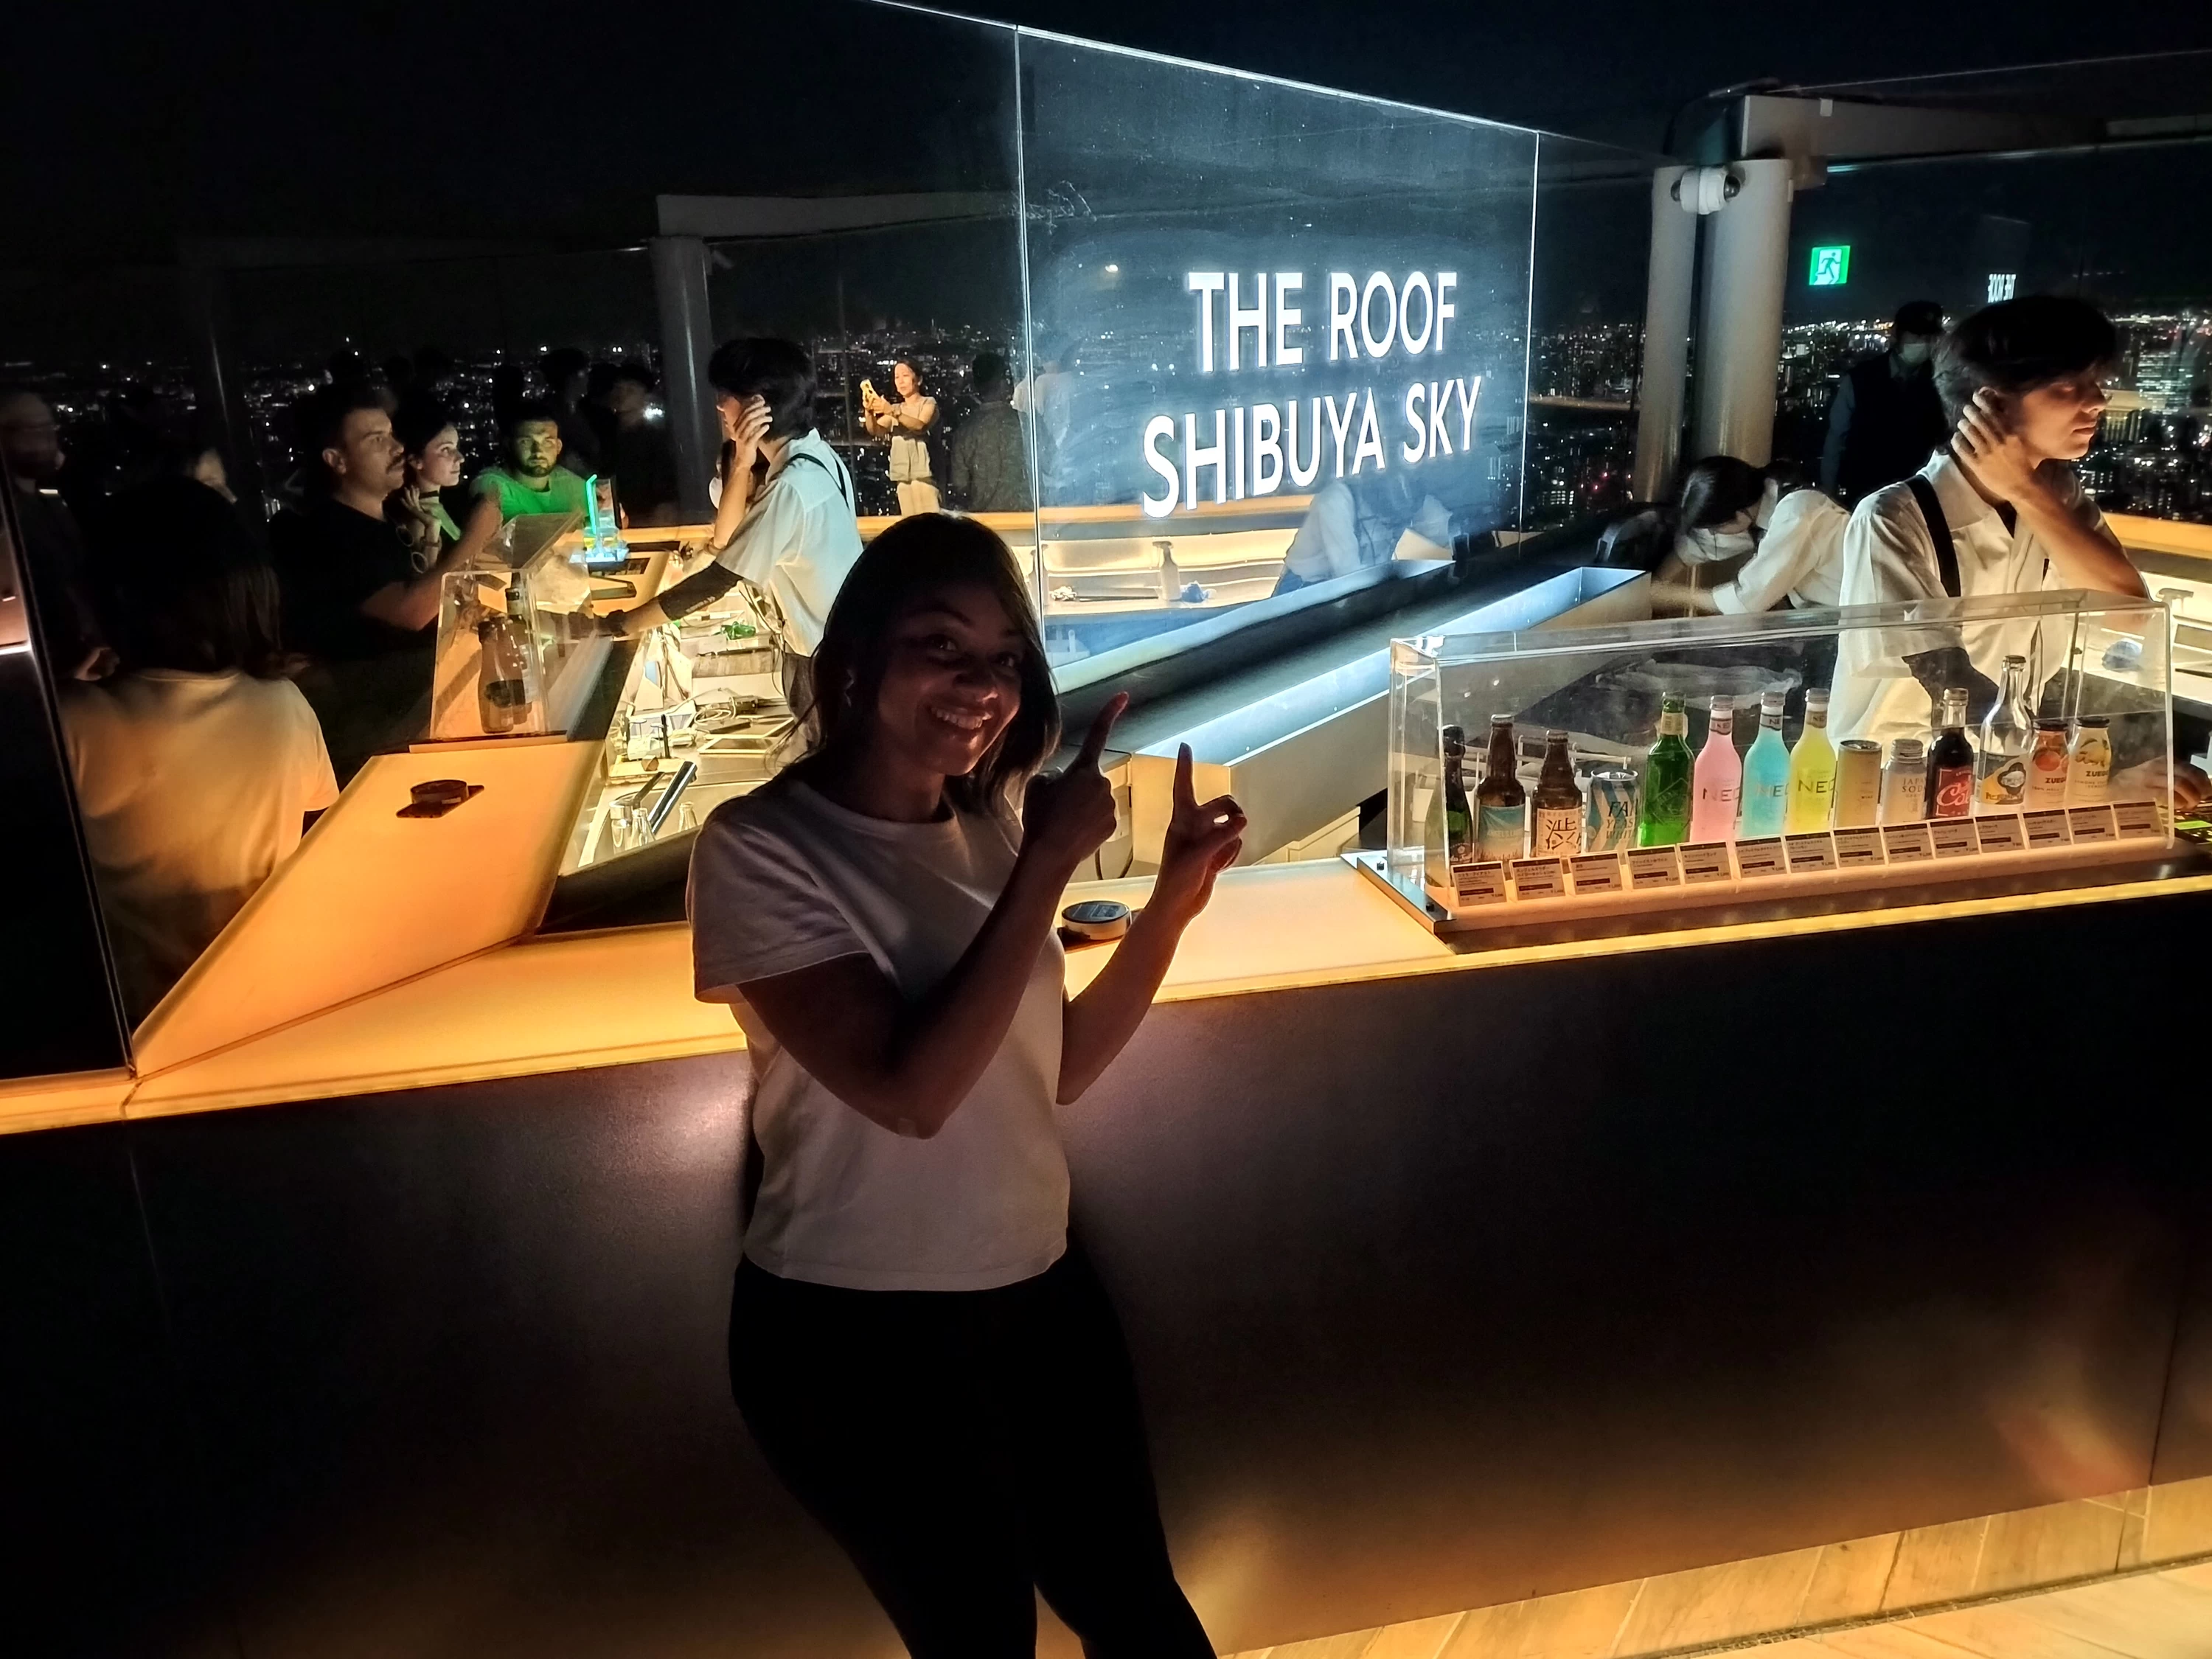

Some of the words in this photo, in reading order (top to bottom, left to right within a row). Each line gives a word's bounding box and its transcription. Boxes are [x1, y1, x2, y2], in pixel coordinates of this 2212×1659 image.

[1188, 271, 1304, 373] THE
[1329, 270, 1458, 362] ROOF
[1142, 386, 1385, 519] SHIBUYA
[1402, 375, 1482, 465] SKY
[1606, 818, 1635, 830] YEAS
[1606, 830, 1634, 839] WHIT
